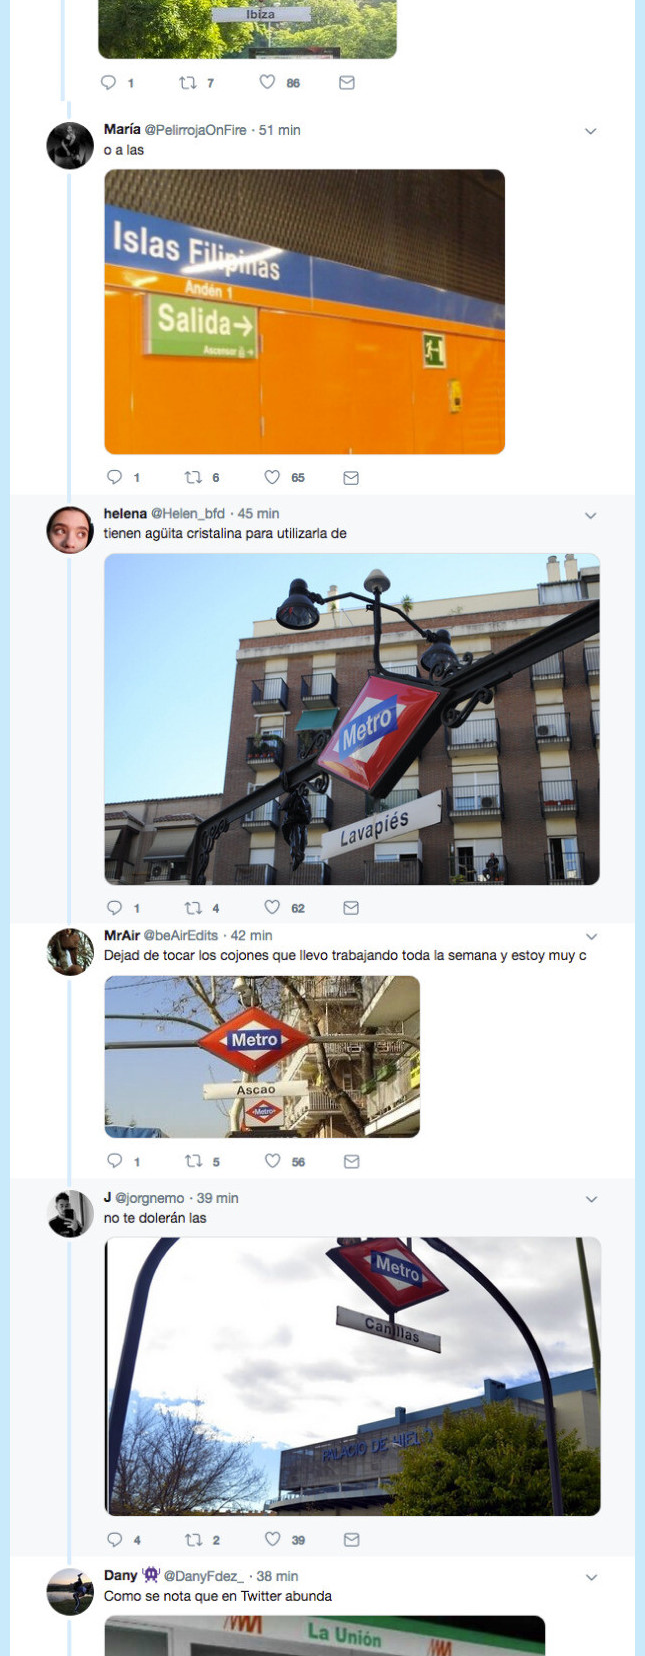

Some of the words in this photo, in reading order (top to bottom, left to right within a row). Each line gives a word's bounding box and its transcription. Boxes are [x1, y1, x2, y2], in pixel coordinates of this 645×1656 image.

[246, 9, 275, 19] Ibiza
[113, 220, 180, 262] Islas
[189, 238, 281, 281] Filipinas
[184, 279, 222, 299] Andén
[226, 287, 233, 300] 1
[158, 302, 231, 336] Salida
[102, 527, 141, 540] tienen
[144, 527, 183, 542] agüita
[186, 526, 242, 540] cristalina
[244, 529, 273, 542] para
[276, 527, 328, 540] utilizarla
[330, 527, 347, 540] de
[342, 708, 393, 751] Metro
[340, 810, 409, 847] Lavapiés
[231, 1033, 278, 1047] Metro
[236, 1085, 276, 1095] Ascao
[253, 1108, 274, 1116] Metro
[103, 1213, 120, 1224] no
[122, 1212, 135, 1224] te
[138, 1210, 185, 1224] dolerán
[188, 1211, 207, 1224] las
[376, 1253, 420, 1283] Metro
[365, 1317, 420, 1344] Canillas
[321, 1441, 368, 1462] PALACIO
[371, 1437, 389, 1453] DE
[308, 1622, 330, 1640] La
[335, 1627, 382, 1648] Unión
